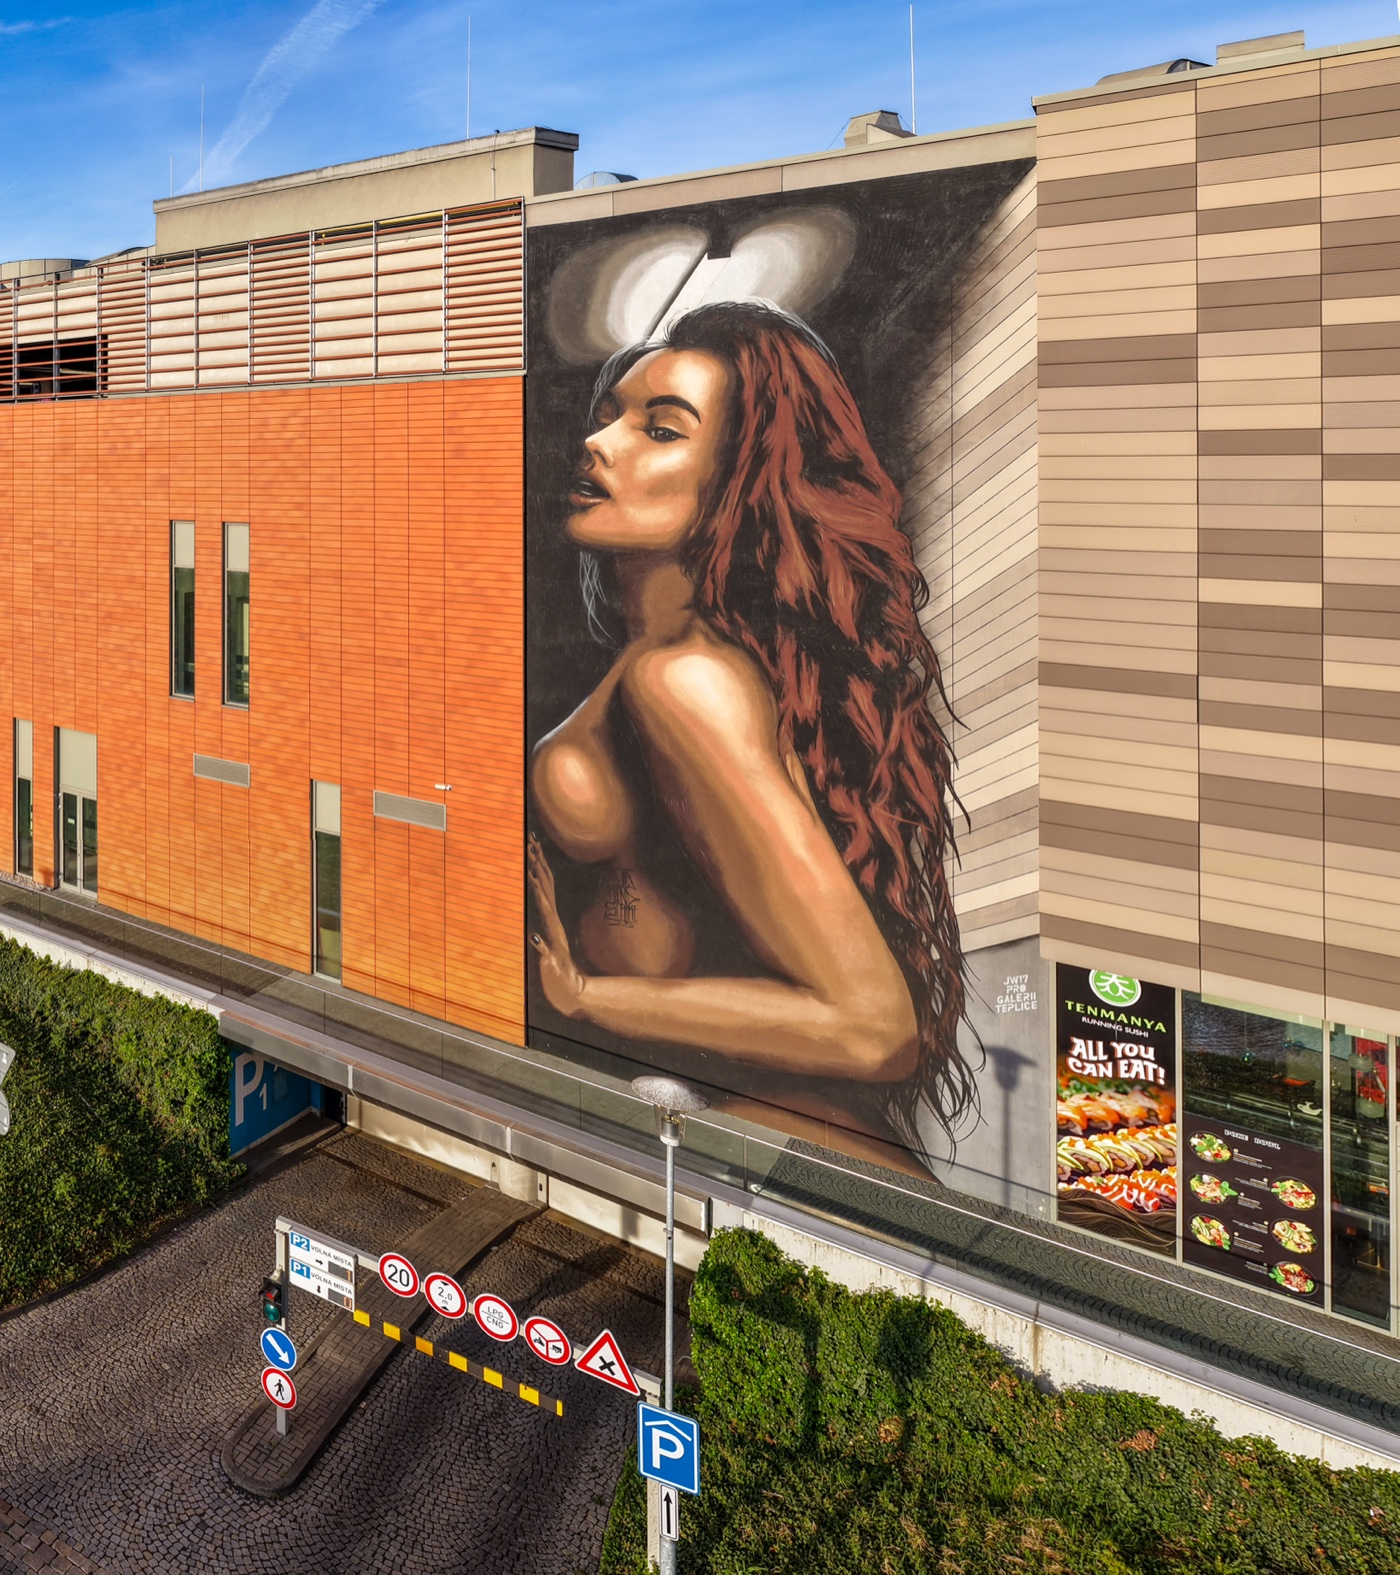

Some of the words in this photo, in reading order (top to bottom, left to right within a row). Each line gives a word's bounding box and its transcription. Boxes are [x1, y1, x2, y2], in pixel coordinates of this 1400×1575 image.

[1003, 974, 1029, 985] JW17
[1006, 984, 1027, 994] PRO
[995, 1001, 1038, 1013] TEPLICE
[996, 992, 1036, 1004] GALERII
[1065, 1000, 1167, 1033] TENMANYA
[1081, 1016, 1123, 1032] RUNNING
[1124, 1026, 1149, 1038] SUSHI
[1070, 1036, 1108, 1061] ALL
[1110, 1041, 1156, 1061] YOU
[1066, 1056, 1113, 1078] CAN
[1117, 1058, 1166, 1086] EAT!
[292, 1233, 308, 1251] P2
[310, 1244, 332, 1259] VOLNÁ
[333, 1254, 352, 1267] MÍSTA
[293, 1261, 308, 1278] P1
[310, 1272, 332, 1286] VOLNÁ
[333, 1282, 352, 1295] MÍSTA
[387, 1263, 410, 1287] 20
[438, 1286, 453, 1301] 2.0
[486, 1315, 504, 1329] CNG
[487, 1306, 504, 1319] LPG
[652, 1427, 685, 1470] P
